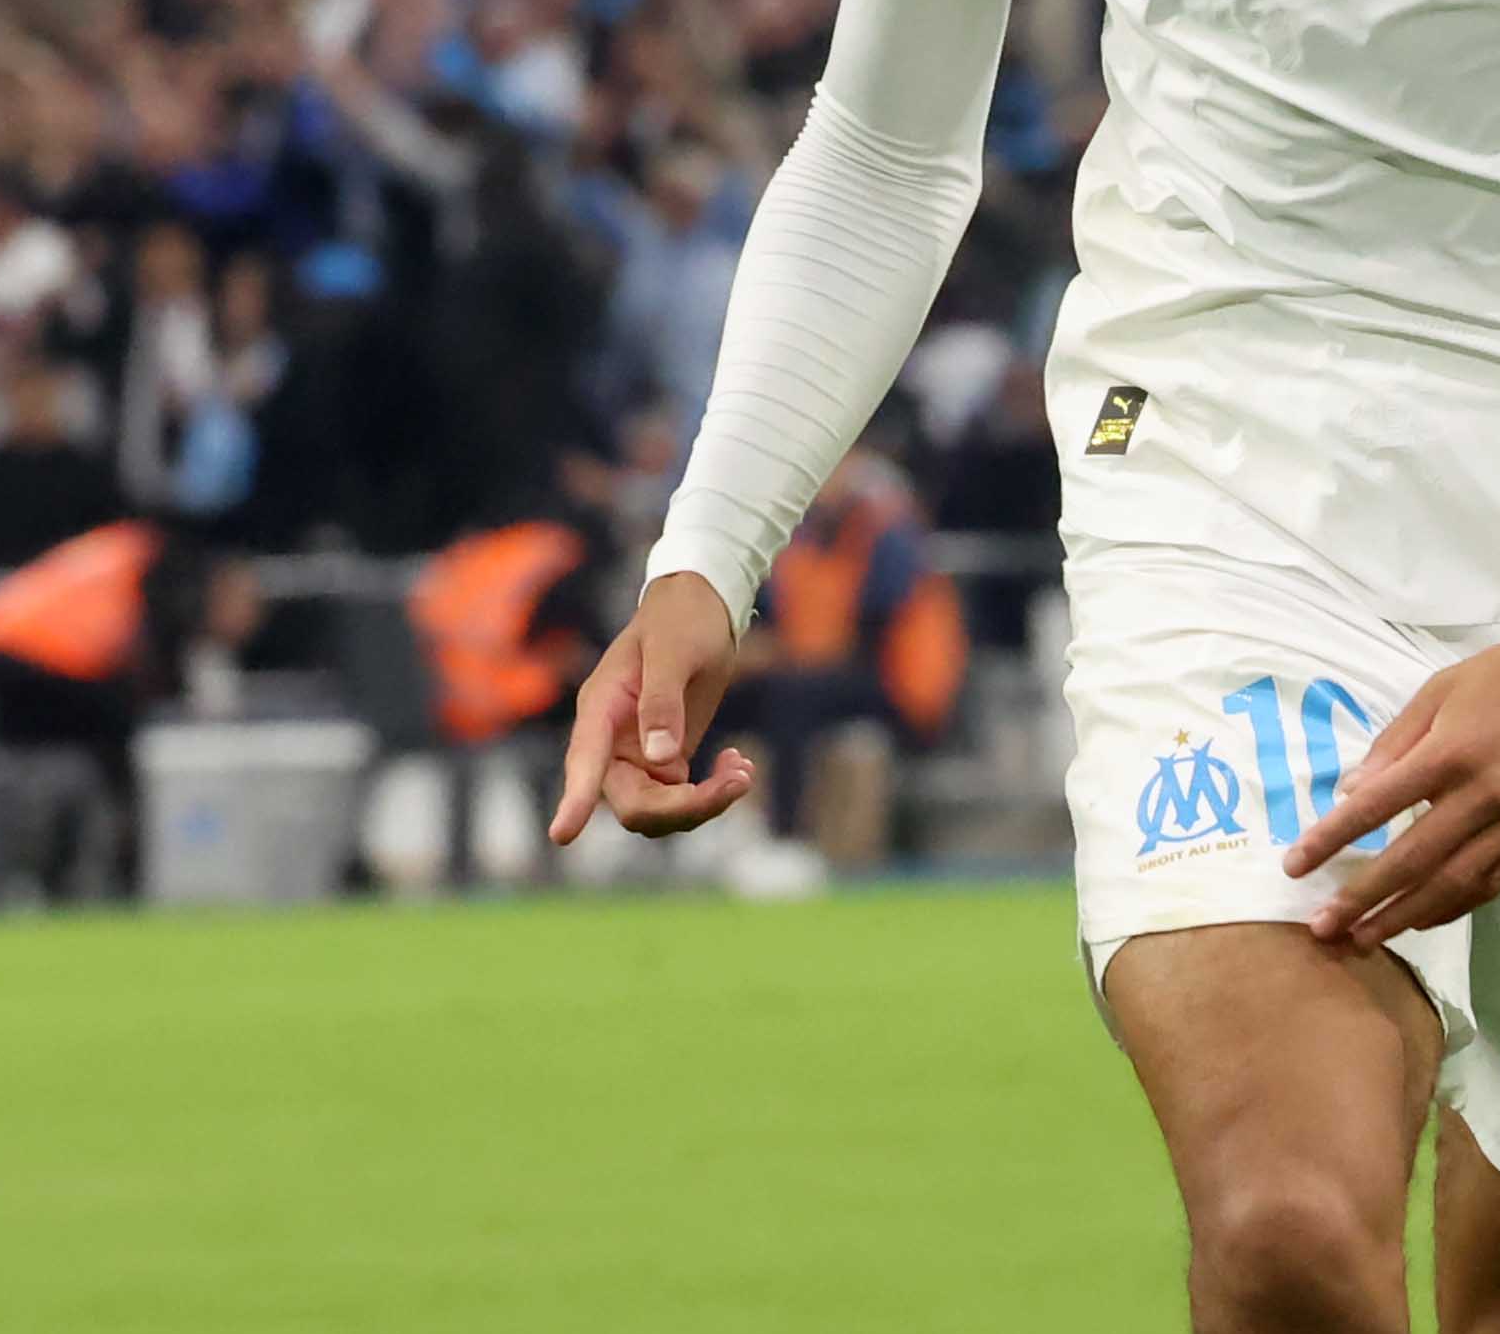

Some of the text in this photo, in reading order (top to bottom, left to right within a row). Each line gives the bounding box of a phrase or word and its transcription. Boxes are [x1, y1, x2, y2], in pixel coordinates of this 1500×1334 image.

[1137, 837, 1250, 874] DROIT AU BUT
